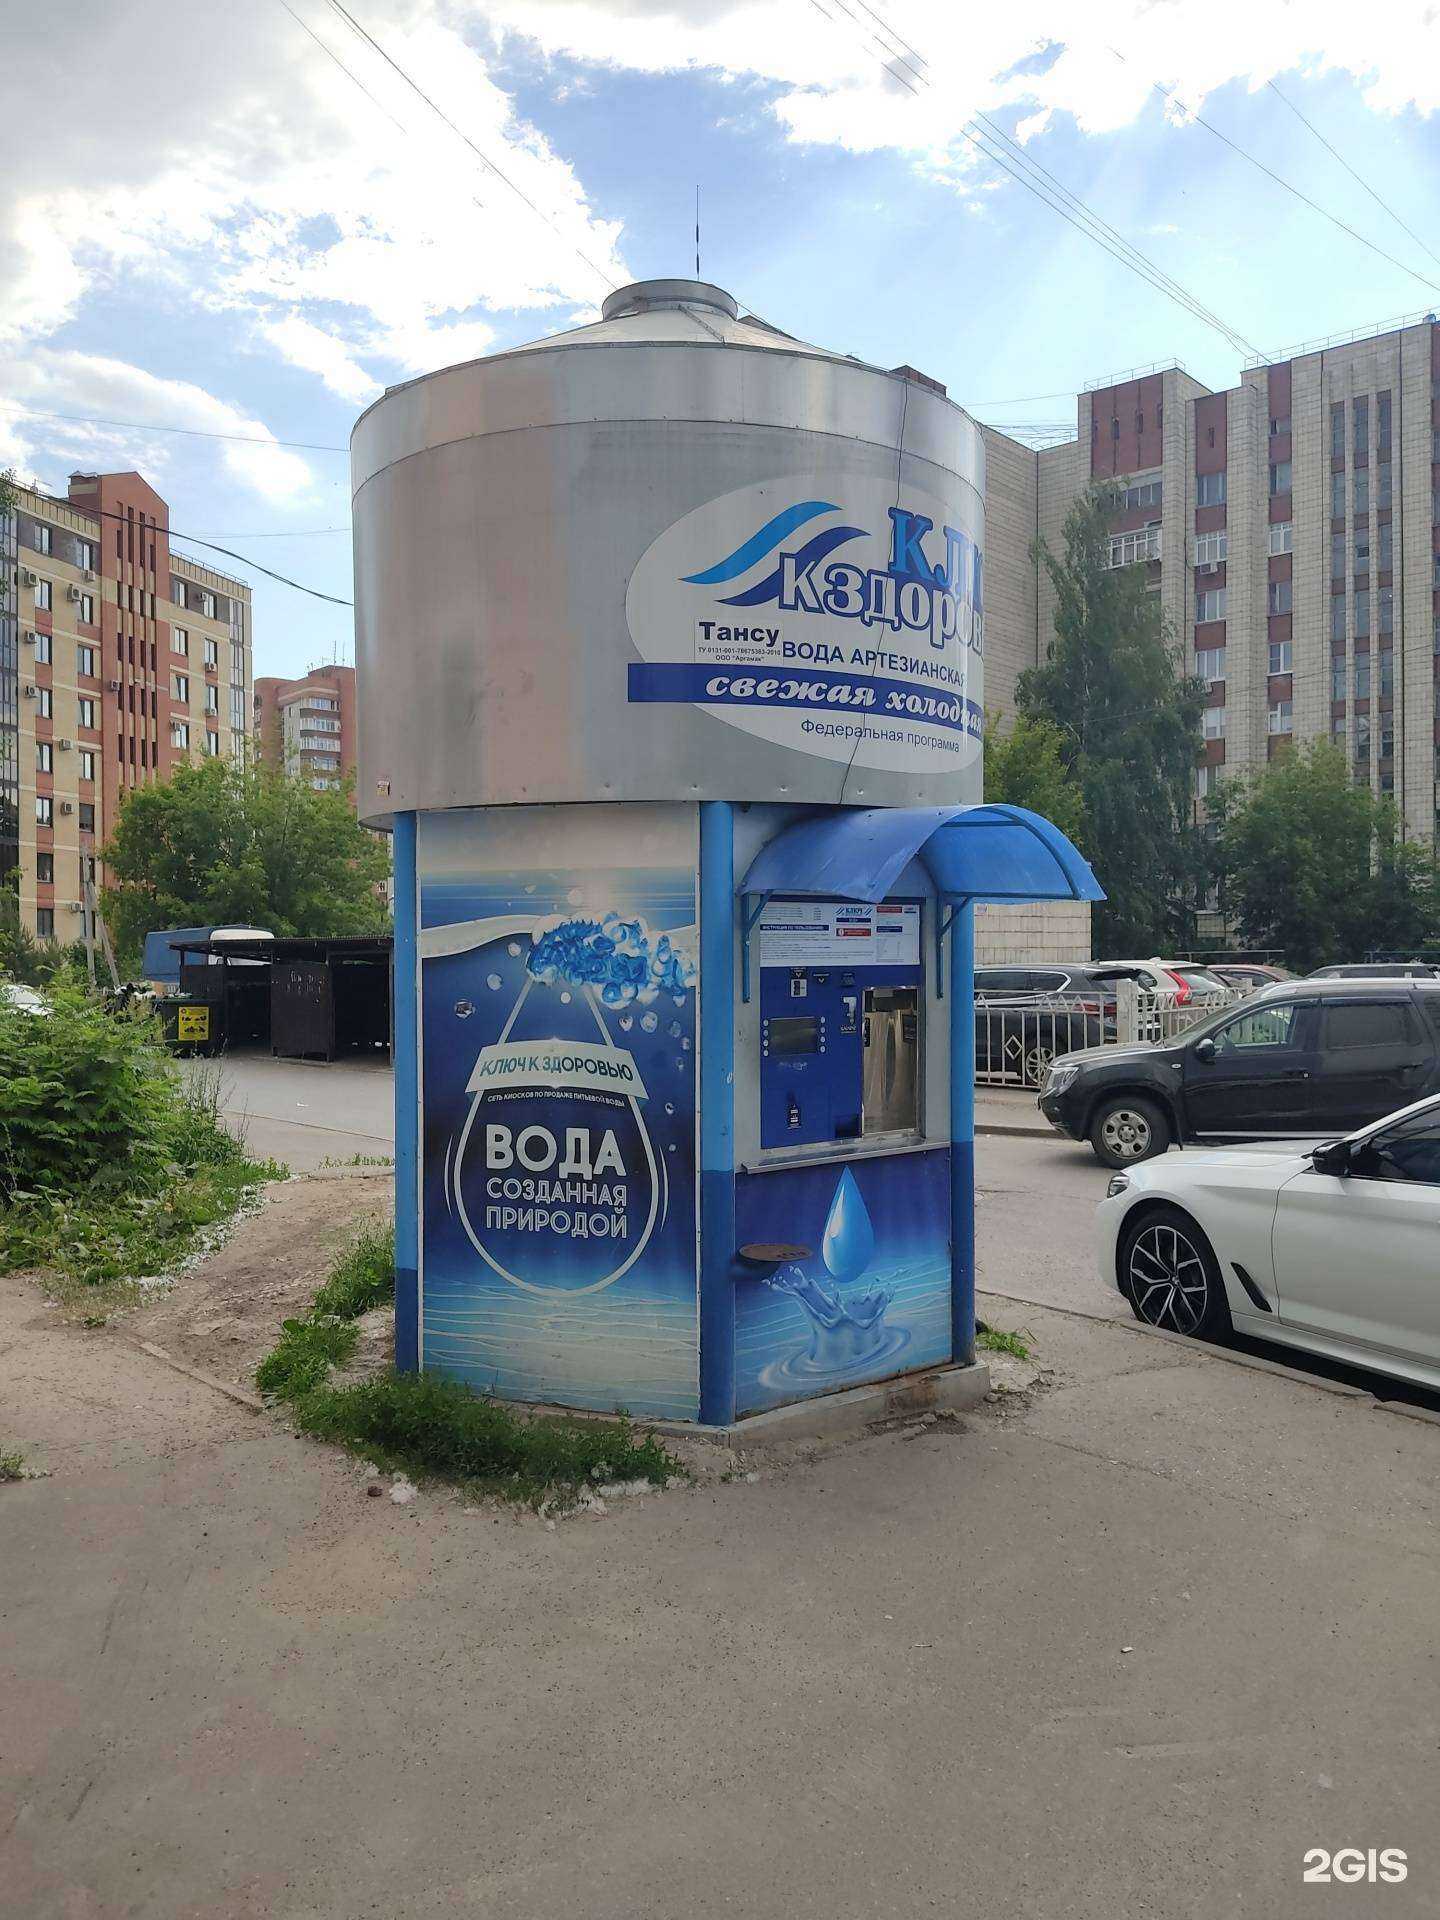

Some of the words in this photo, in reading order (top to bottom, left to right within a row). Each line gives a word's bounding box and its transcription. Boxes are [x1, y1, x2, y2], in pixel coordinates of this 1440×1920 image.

[699, 622, 779, 647] Тансу
[782, 641, 844, 664] ВОДА
[850, 649, 966, 688] АРТЕЗИАНСКАЯ
[705, 673, 876, 707] свежая
[801, 719, 904, 742] Федеральная
[907, 731, 960, 753] программа
[480, 1057, 527, 1077] КЛЮЧ
[528, 1056, 540, 1072] К
[542, 1056, 634, 1082] ЗДОРОВЬЮ
[503, 1092, 534, 1101] КИОСКОВ
[544, 1091, 574, 1099] ПРОДАЖЕ
[486, 1123, 627, 1180] ВОДА
[486, 1177, 627, 1207] СОЗДАННАЯ
[486, 1206, 627, 1238] ПРИРОДОЙ
